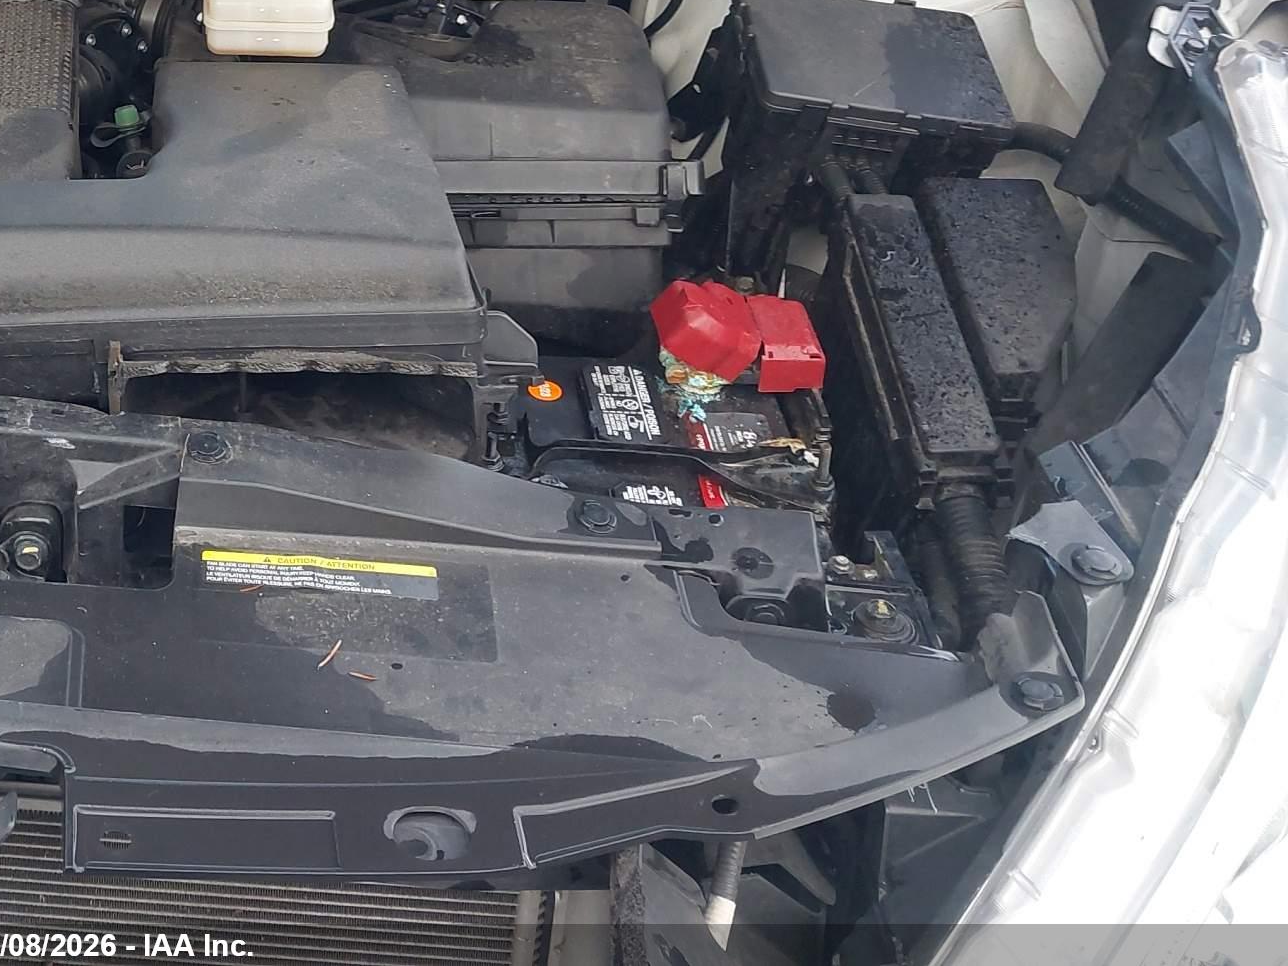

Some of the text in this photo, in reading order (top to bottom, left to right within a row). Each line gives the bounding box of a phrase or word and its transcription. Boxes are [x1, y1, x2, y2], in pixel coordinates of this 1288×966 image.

[634, 376, 651, 403] DANGER
[644, 409, 661, 436] POISON
[277, 556, 316, 566] CAUTION
[326, 561, 375, 570] ATTENTION
